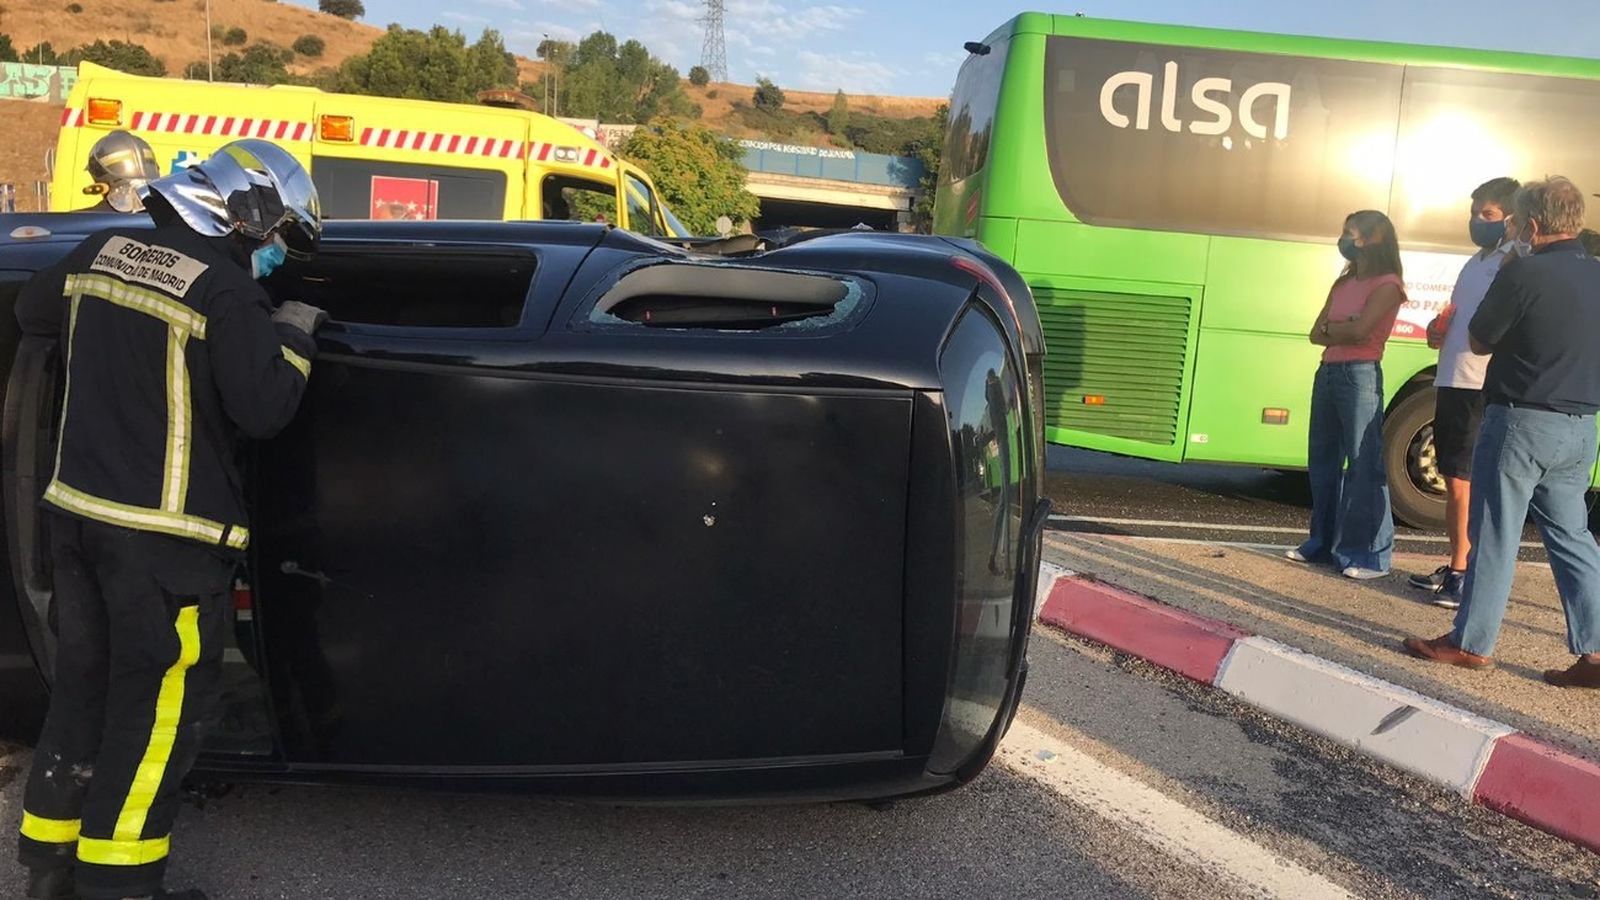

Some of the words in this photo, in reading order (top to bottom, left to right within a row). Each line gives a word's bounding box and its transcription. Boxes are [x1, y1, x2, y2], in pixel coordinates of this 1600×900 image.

[1100, 61, 1291, 140] alsa
[138, 265, 149, 279] DE
[149, 268, 186, 291] MADRID
